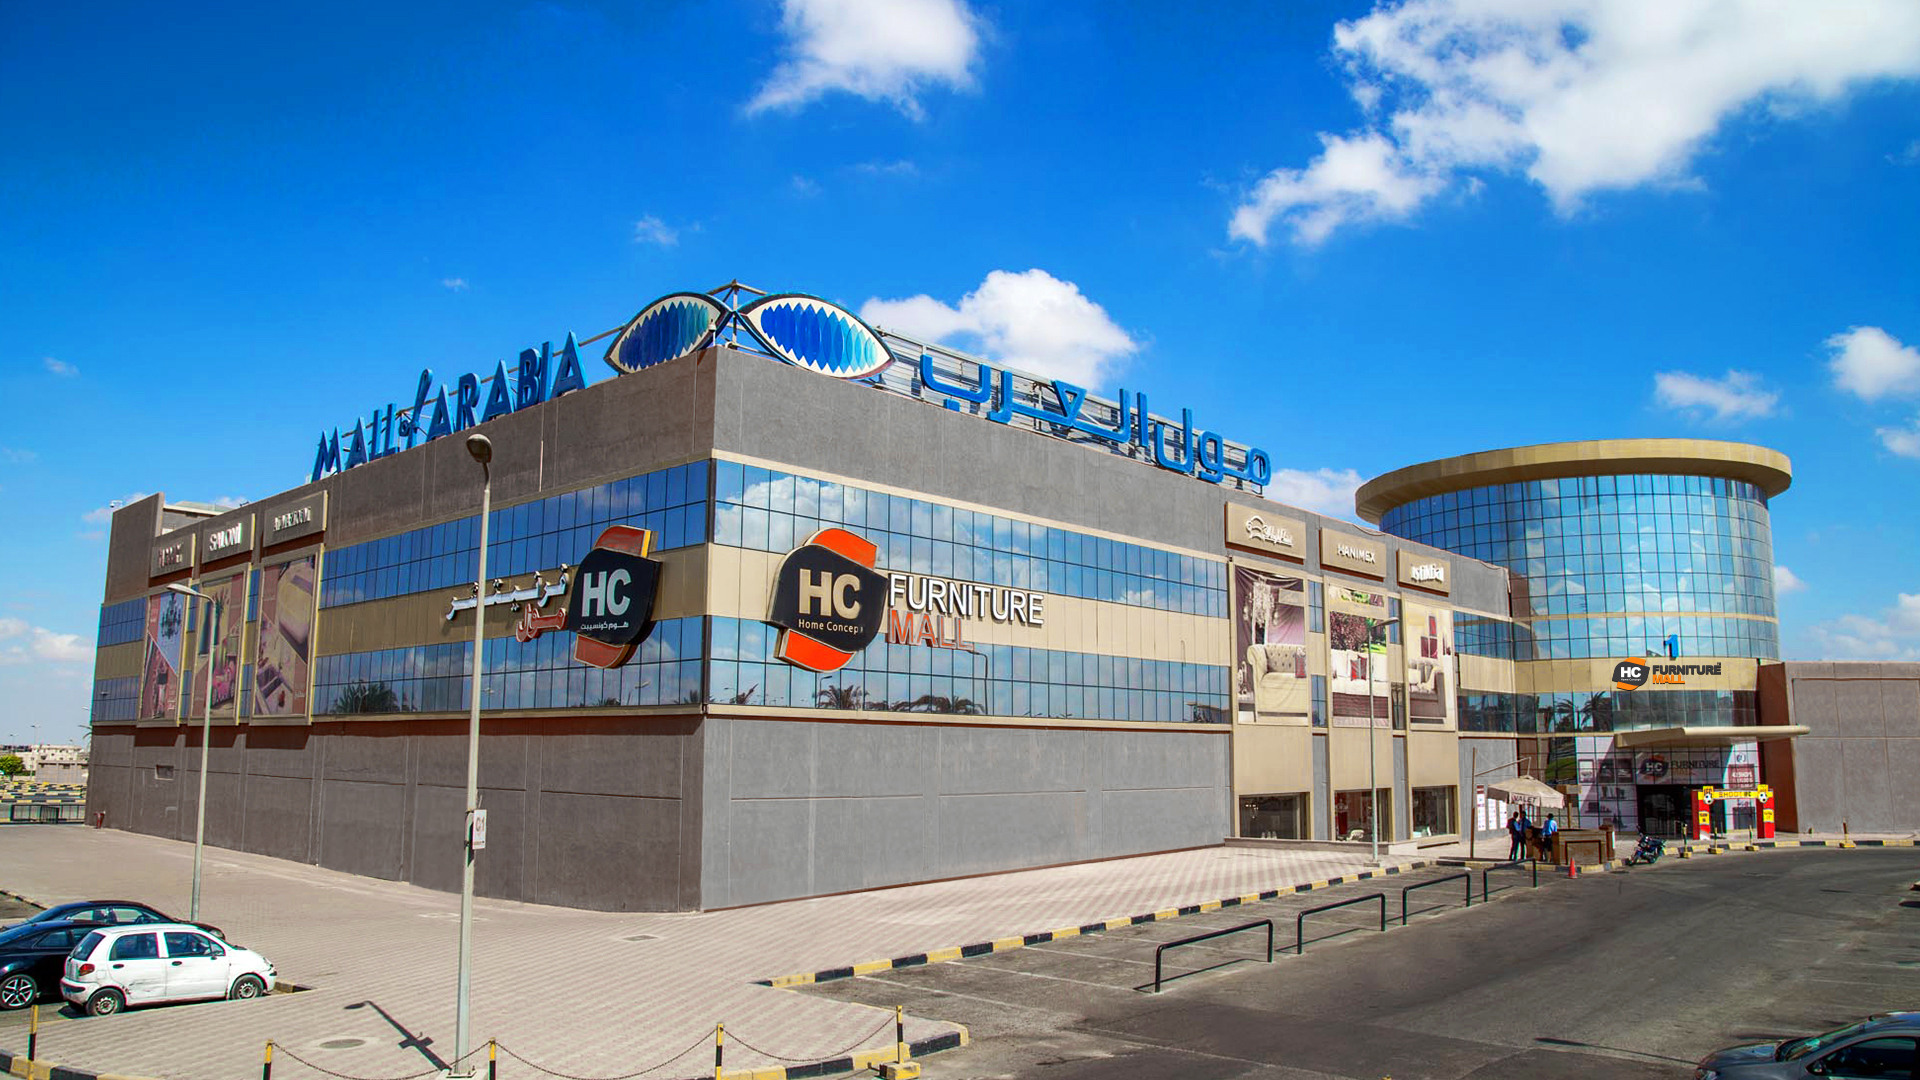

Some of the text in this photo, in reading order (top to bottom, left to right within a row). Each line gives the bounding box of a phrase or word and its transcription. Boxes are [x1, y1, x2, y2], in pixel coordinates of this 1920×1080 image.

[311, 403, 398, 483] MALL
[426, 330, 588, 442] ARABIA
[919, 354, 1271, 487] مول العرب
[1337, 543, 1376, 564] HANIMEX
[581, 568, 632, 618] HC
[798, 568, 862, 621] HC
[889, 573, 1045, 626] FURNITURE
[515, 603, 568, 643] مول
[798, 618, 825, 630] Home
[887, 608, 975, 651] MALL
[1620, 666, 1641, 678] HC
[1652, 664, 1721, 676] FURNITURE
[1652, 674, 1685, 684] MALL
